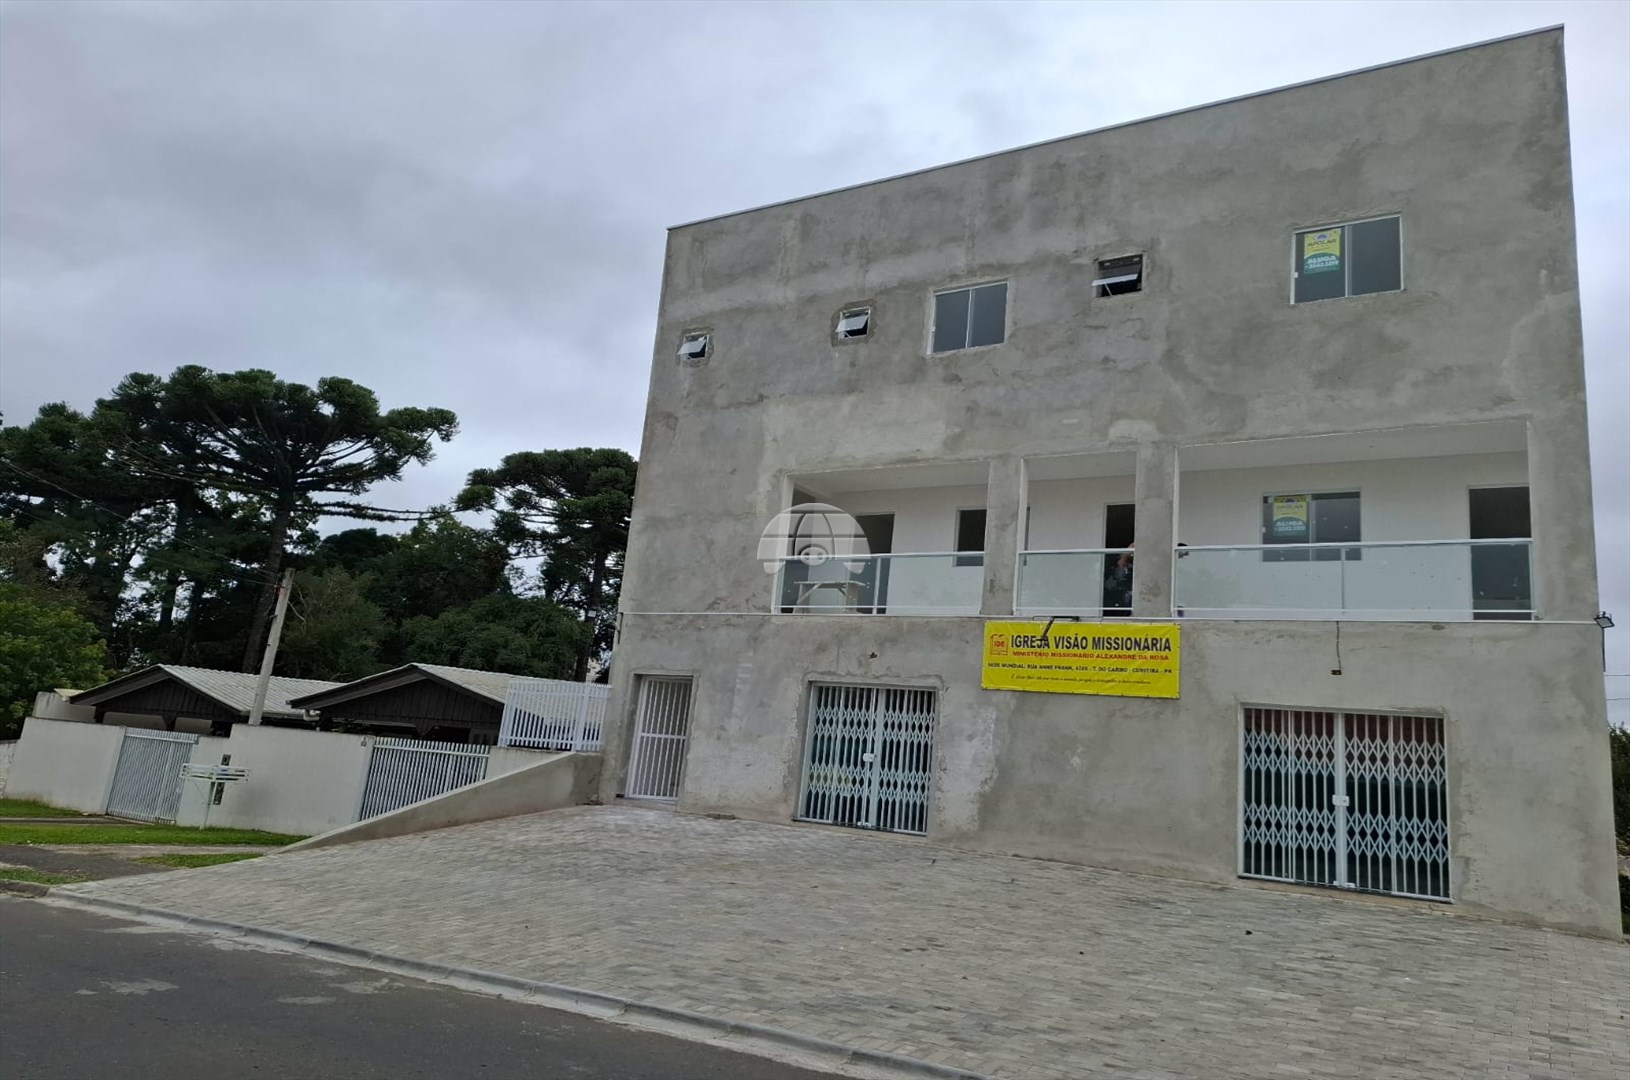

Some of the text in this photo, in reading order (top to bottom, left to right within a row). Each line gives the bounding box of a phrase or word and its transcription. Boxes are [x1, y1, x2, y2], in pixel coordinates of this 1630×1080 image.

[1011, 633, 1171, 651] IGREJA VISÃO MISSIONÁRIA
